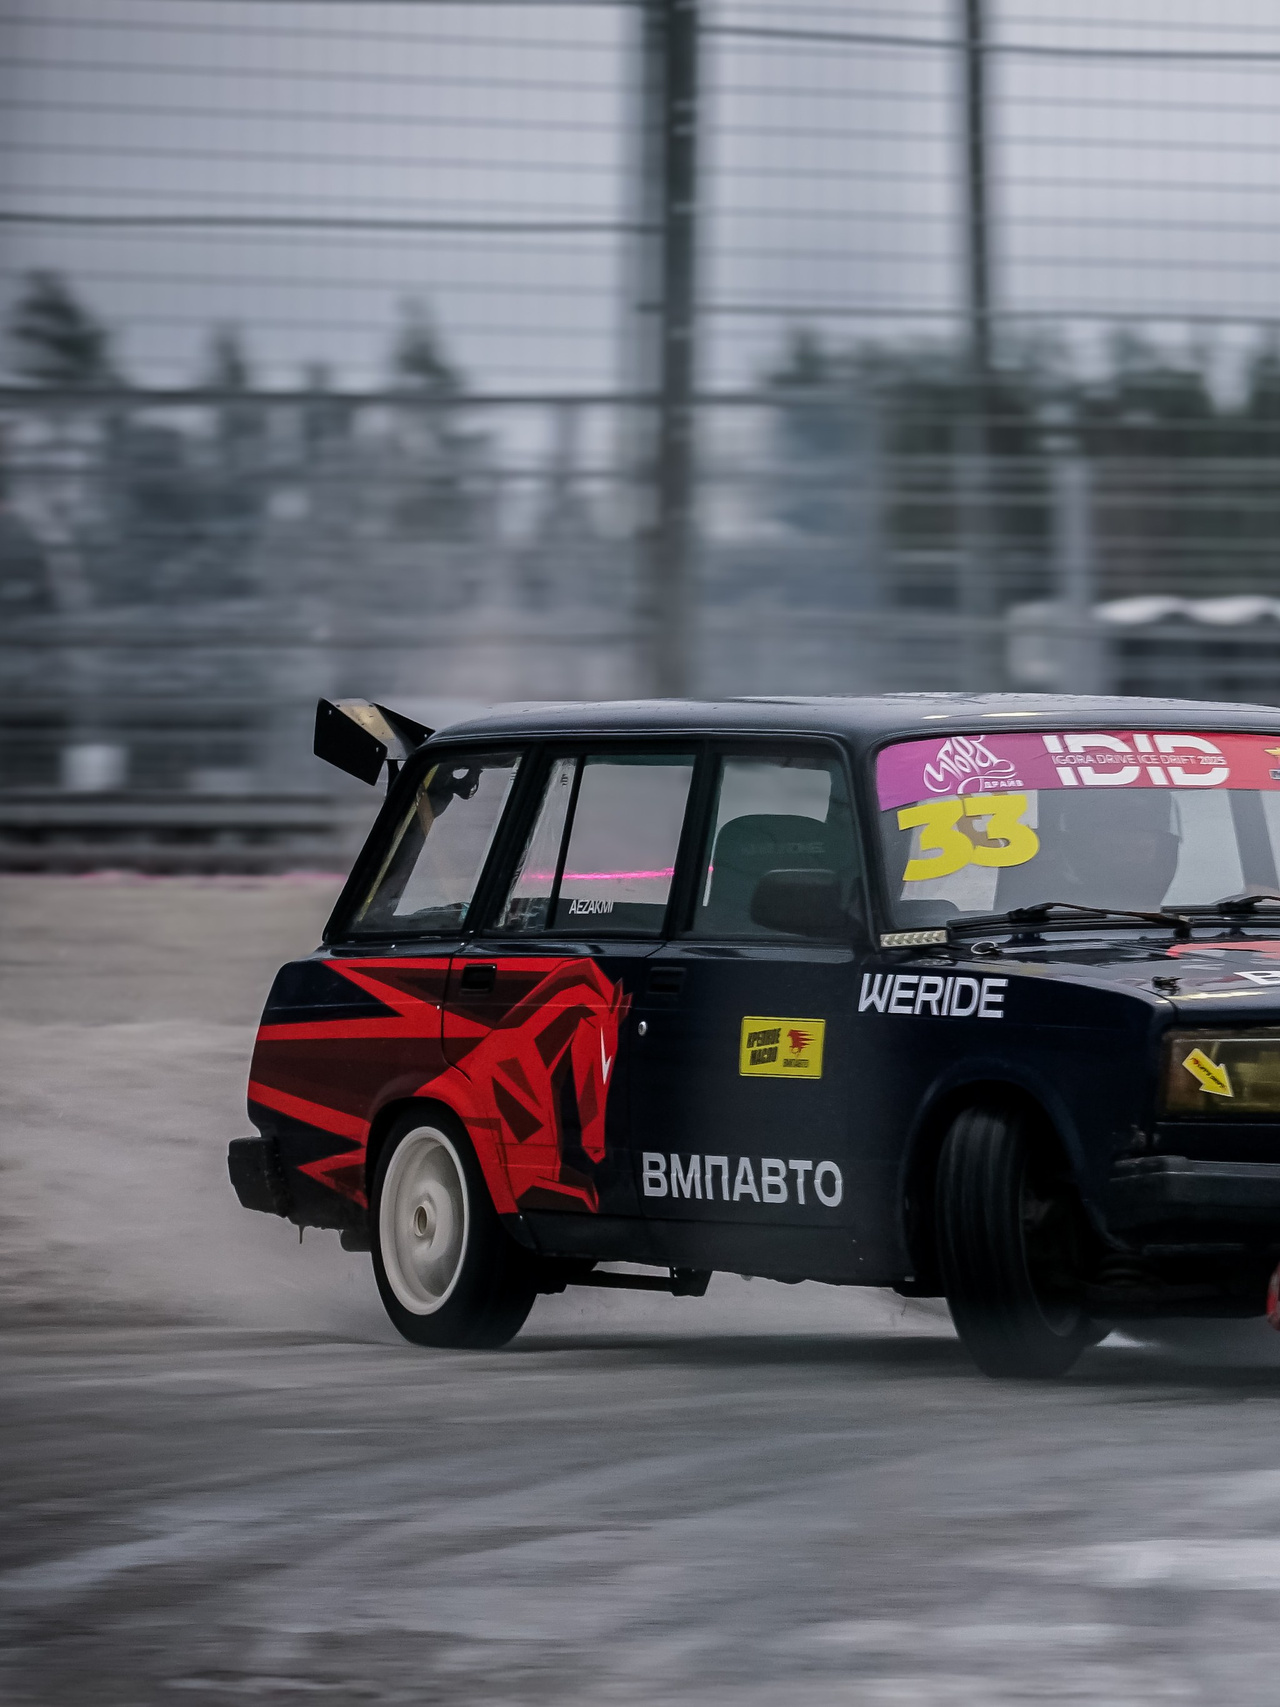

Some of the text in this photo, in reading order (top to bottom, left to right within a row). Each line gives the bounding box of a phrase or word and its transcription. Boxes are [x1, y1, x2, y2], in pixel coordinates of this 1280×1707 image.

[1042, 734, 1229, 785] IDID
[1052, 754, 1227, 765] IGORA DRIVE ICE DRIFT 2025
[897, 794, 1040, 881] 33
[569, 899, 614, 914] AEZAKMI
[858, 973, 1008, 1018] WERIDE
[642, 1152, 843, 1207] ВМПАВТО
